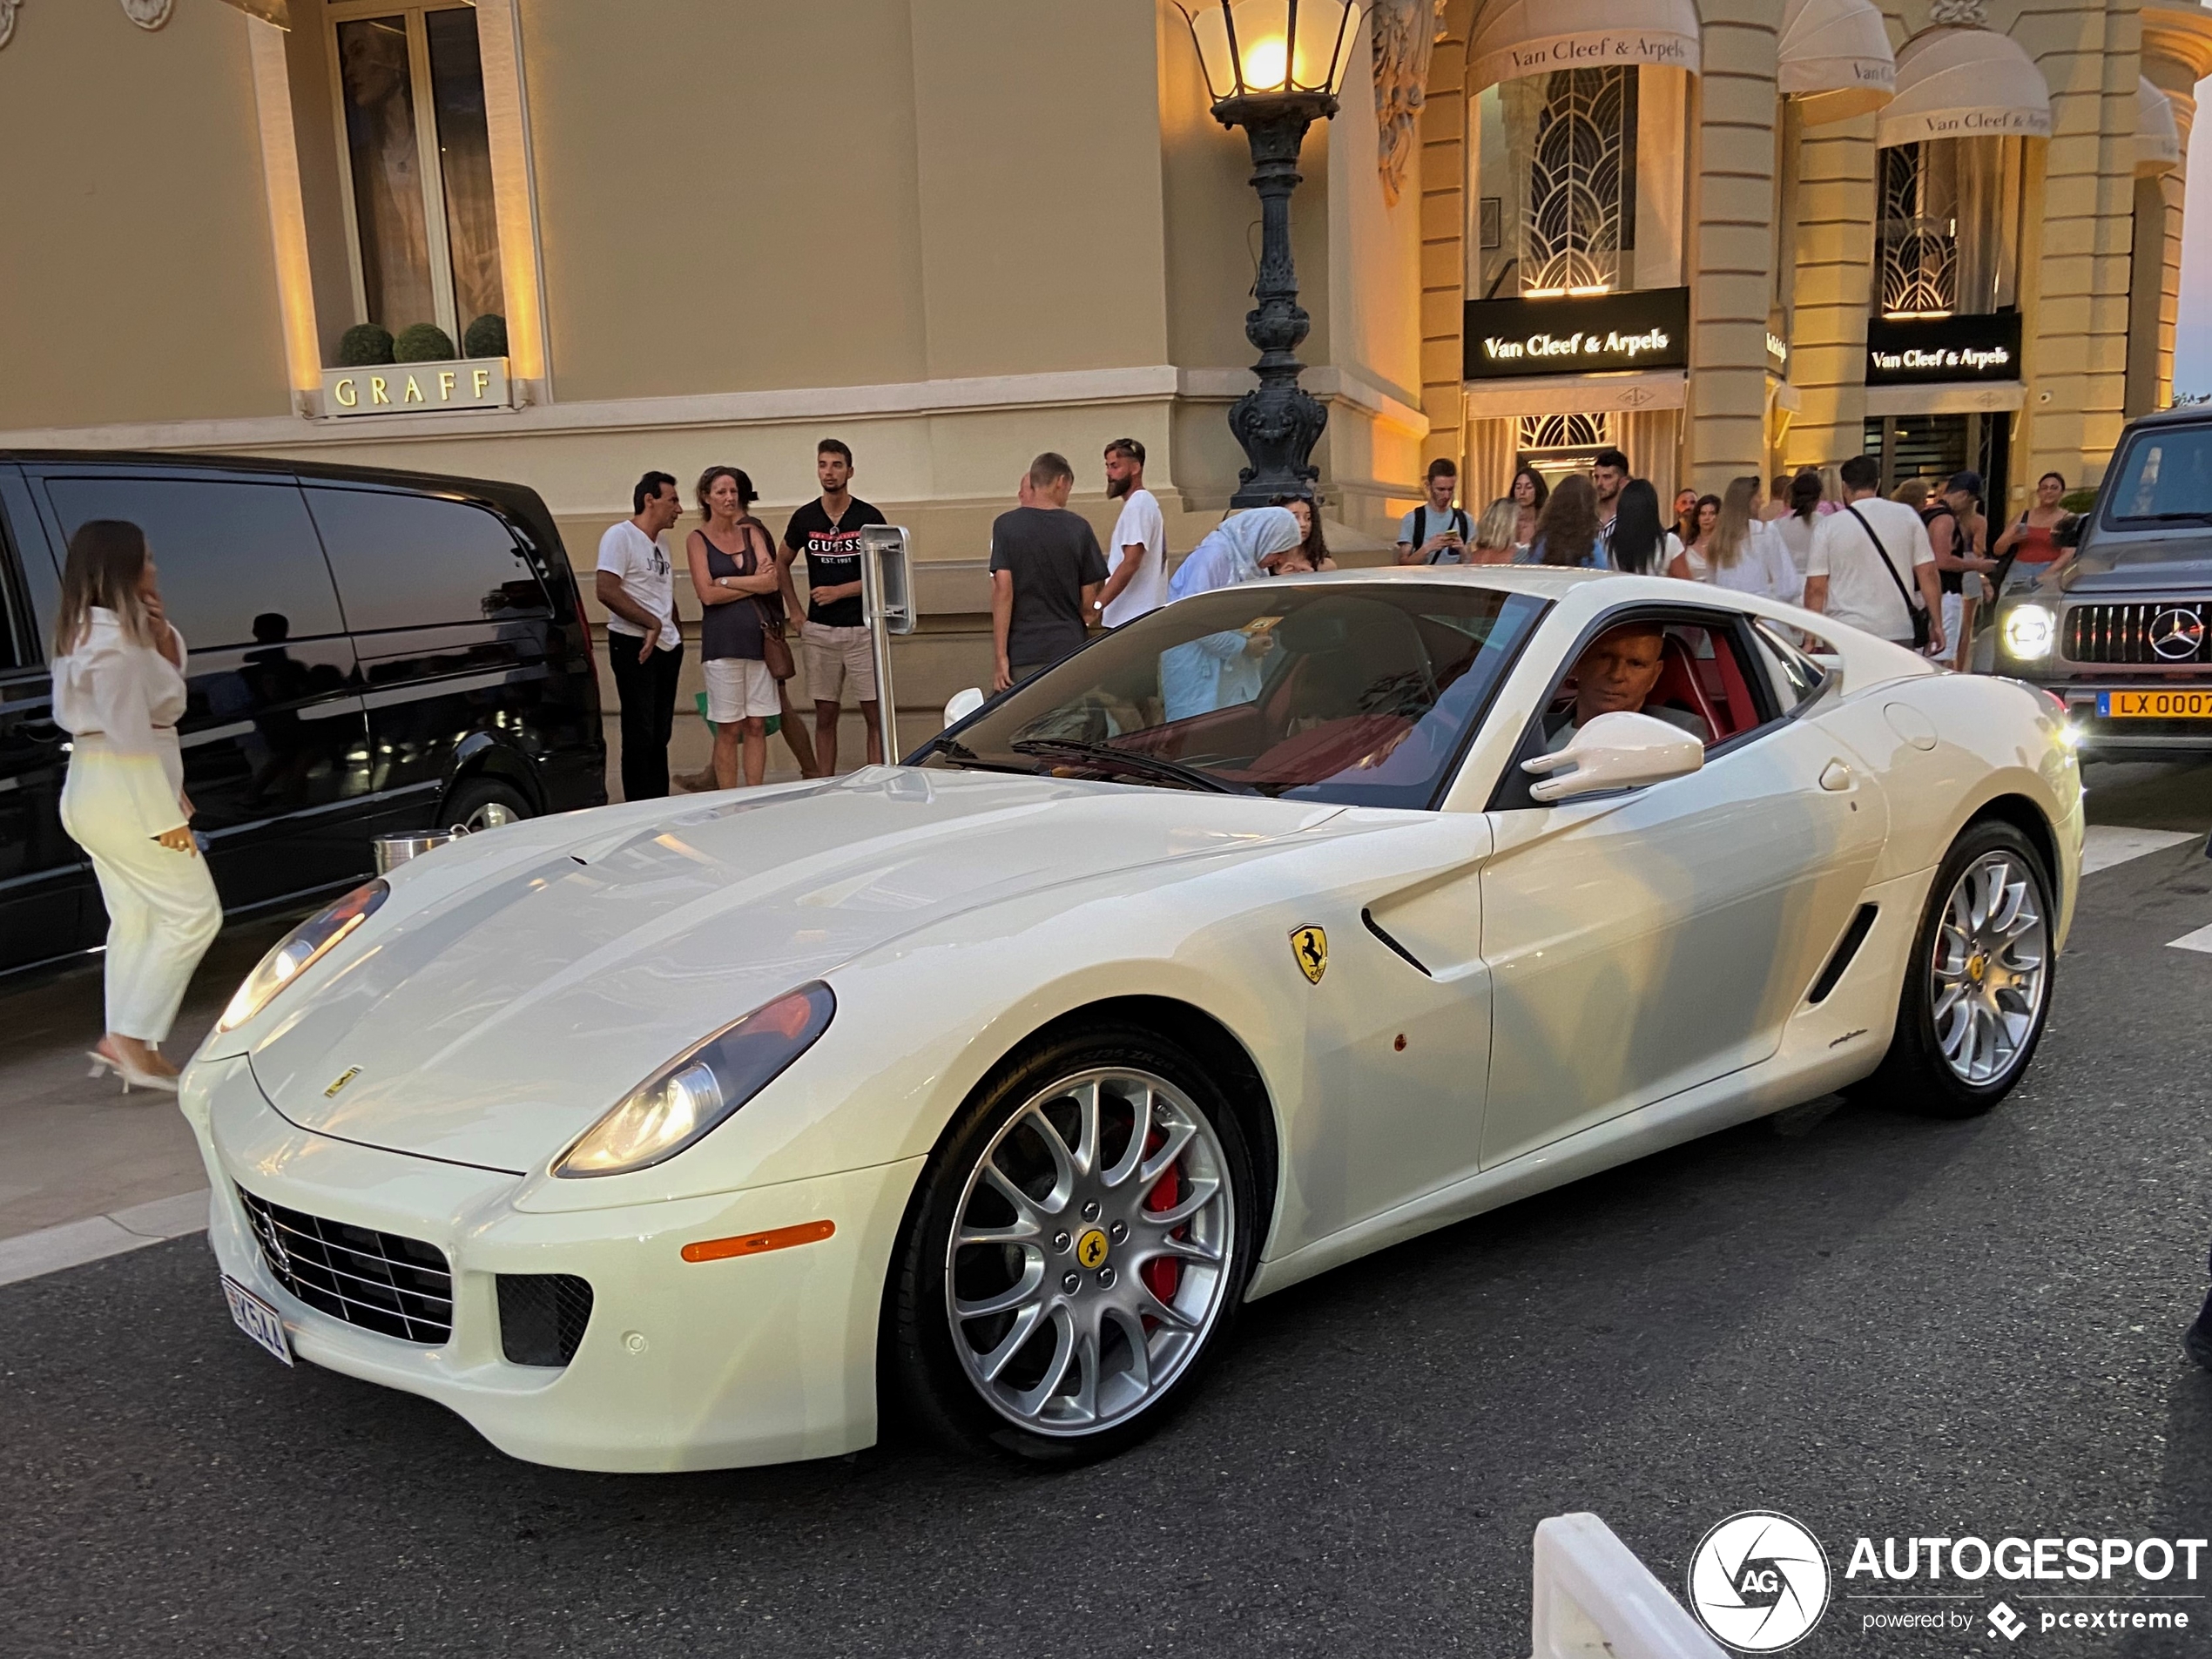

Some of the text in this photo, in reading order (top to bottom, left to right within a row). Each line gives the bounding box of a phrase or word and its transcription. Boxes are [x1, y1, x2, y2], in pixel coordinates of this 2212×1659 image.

[1513, 37, 1684, 67] Van Cleef & Arpels
[1926, 118, 1959, 131] Van
[1965, 111, 2012, 128] Cleef
[1484, 327, 1669, 359] Van Cleef & Arpels
[1871, 347, 2009, 370] Van Cleef & Arpels
[334, 370, 489, 407] GRAFF
[2121, 695, 2148, 713] LX
